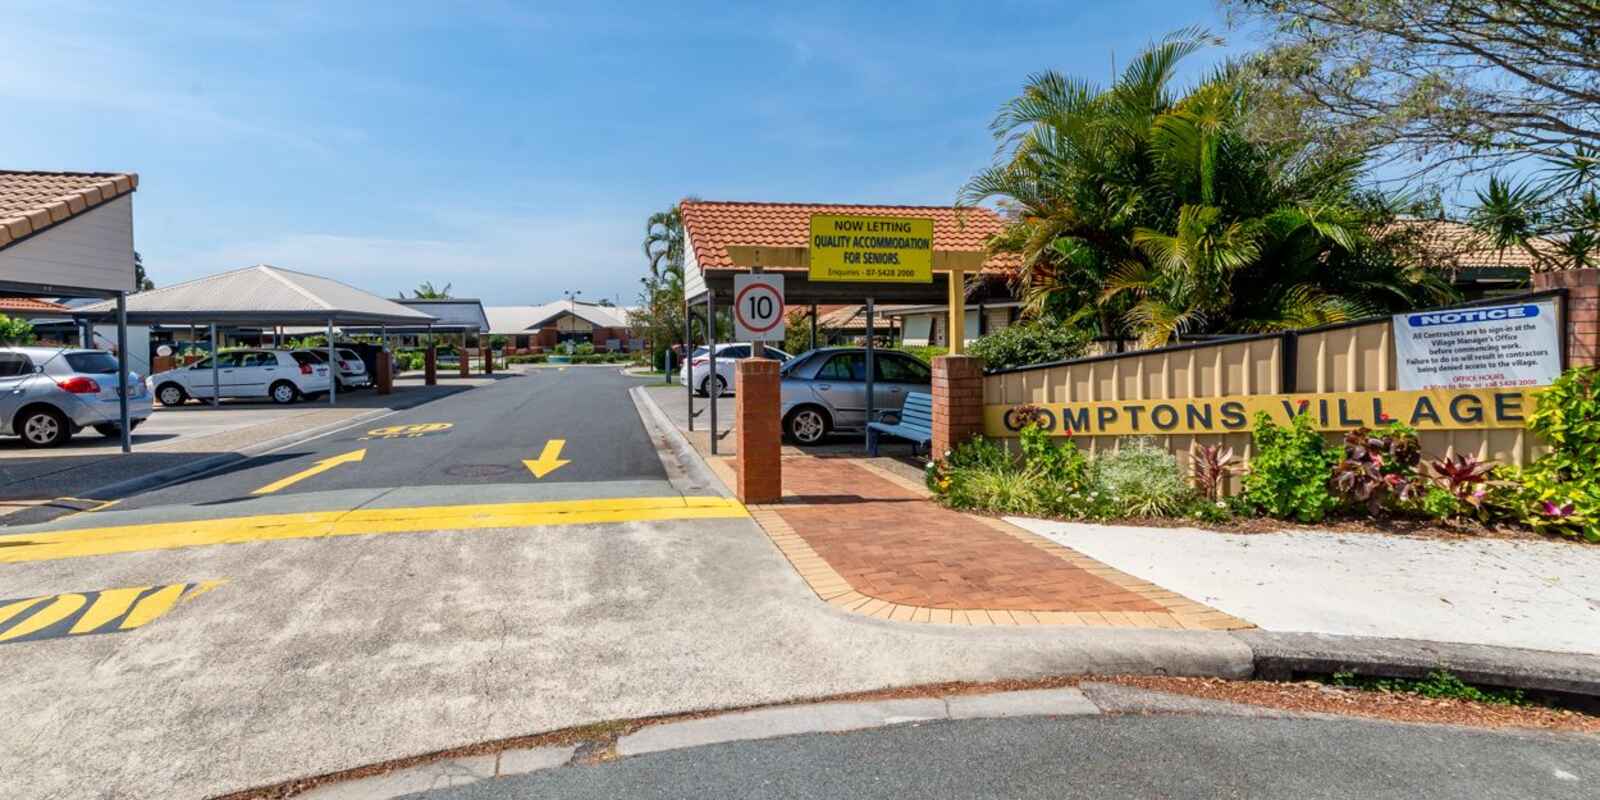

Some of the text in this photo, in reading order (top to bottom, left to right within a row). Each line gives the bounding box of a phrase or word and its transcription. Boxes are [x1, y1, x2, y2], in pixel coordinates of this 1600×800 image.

[834, 220, 912, 233] NOW LETTING
[814, 235, 930, 249] QUALITY ACCOMMODATION
[843, 251, 901, 265] FOR SENIORS.
[828, 268, 860, 278] Enquiries
[749, 296, 772, 320] 10
[1420, 307, 1527, 326] NOTICE
[1412, 332, 1422, 340] All
[1424, 331, 1464, 339] Contractors
[1488, 326, 1513, 335] sign-in
[1431, 339, 1456, 347] Village
[1457, 336, 1493, 345] Manager's
[1429, 347, 1452, 355] before
[1455, 345, 1499, 353] commencing
[1506, 350, 1549, 358] contractors
[1417, 366, 1438, 374] being
[1439, 364, 1463, 372] denied
[1512, 359, 1539, 368] village.
[1452, 373, 1505, 383] OFFICE HOURS
[1281, 392, 1526, 426] VILLAGE
